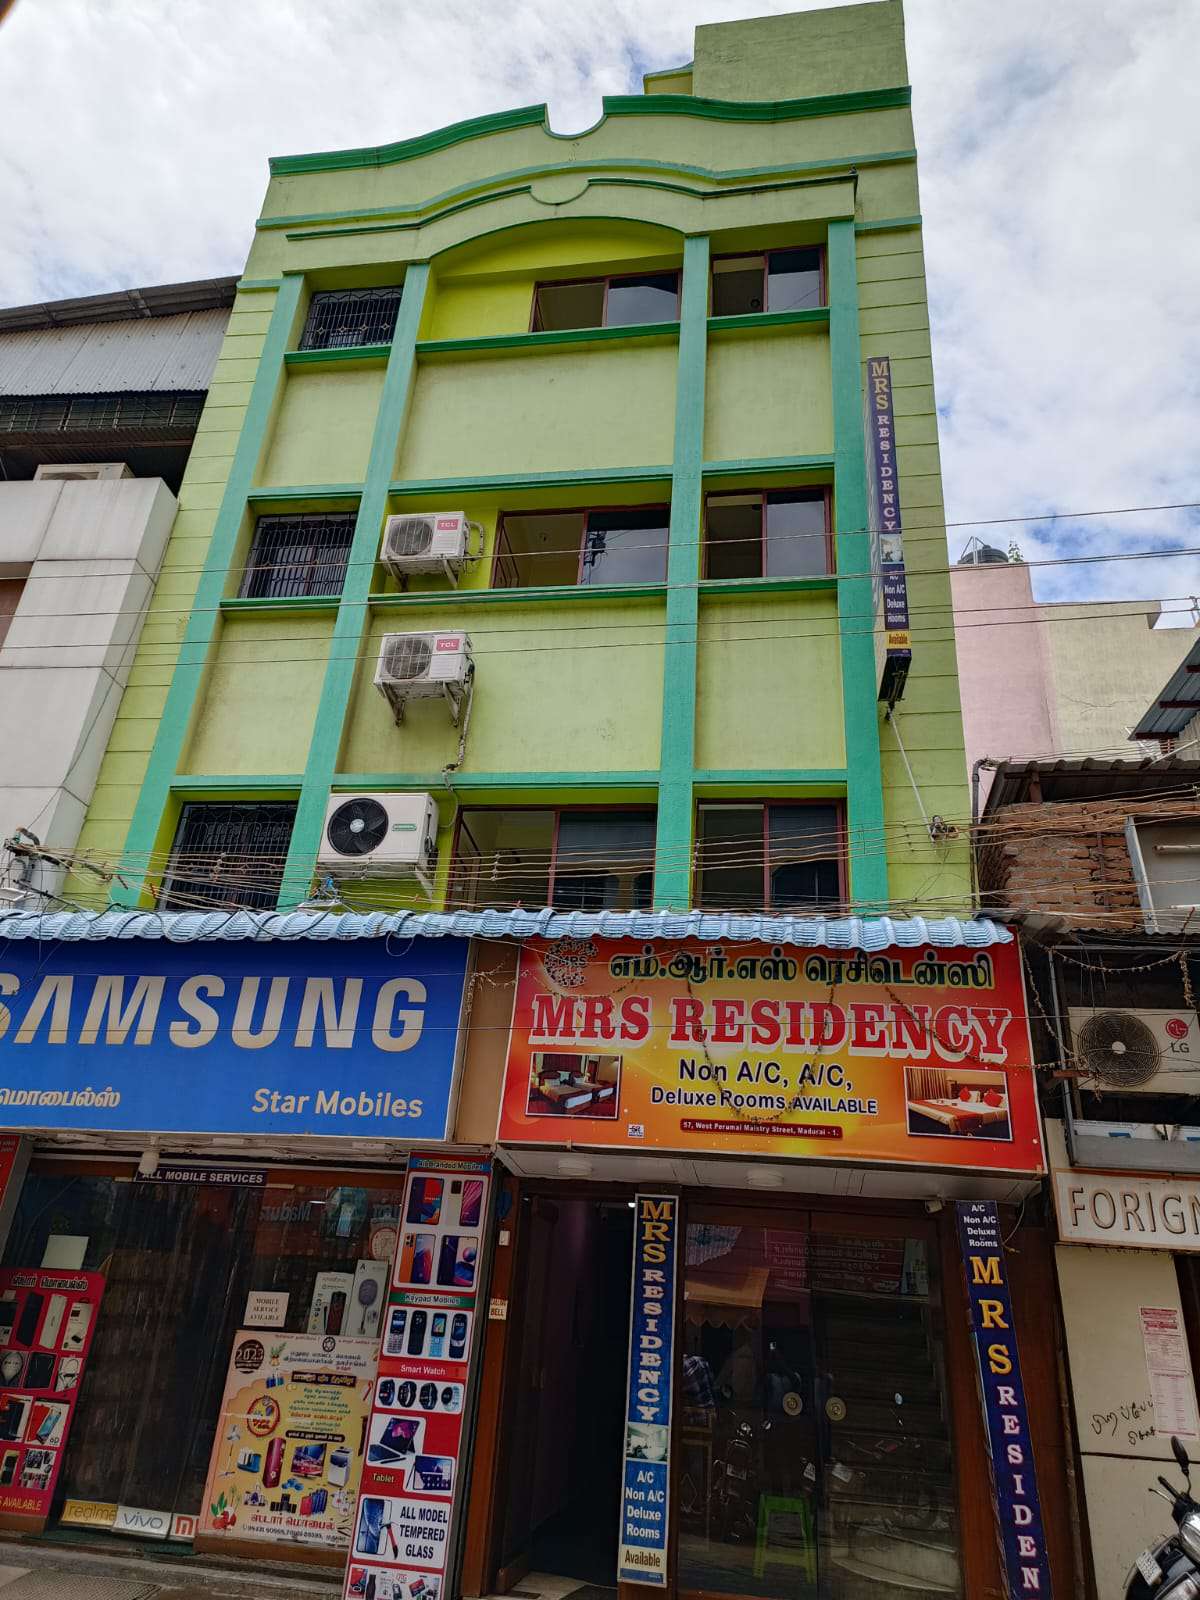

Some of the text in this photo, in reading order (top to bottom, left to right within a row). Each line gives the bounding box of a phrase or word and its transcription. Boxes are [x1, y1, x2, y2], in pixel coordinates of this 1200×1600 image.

[871, 361, 897, 531] MRS RESIDENCY
[529, 994, 1012, 1062] MRS RESIDENCY
[1171, 1042, 1190, 1054] LG
[678, 1058, 728, 1082] Non
[252, 1088, 424, 1118] Star Mobiles
[650, 1086, 878, 1114] Deluxe Rooms AVAILABLE
[695, 1122, 713, 1130] West
[797, 1127, 826, 1136] Madurai
[165, 1172, 207, 1182] MOBILE
[209, 1173, 264, 1184] SERVICES
[971, 1204, 985, 1212] A/C
[963, 1216, 997, 1224] Non A/C
[967, 1227, 996, 1236] Deluxe
[969, 1239, 998, 1248] Rooms
[636, 1200, 673, 1421] MRS RESIDENCY
[969, 1256, 1013, 1375] MRS
[236, 1348, 264, 1361] 2023
[400, 1364, 446, 1376] Smart Watch
[373, 1472, 395, 1483] Tablet
[637, 1470, 654, 1484] A/C
[625, 1487, 665, 1503] Non A/C
[124, 1512, 163, 1529] vivo
[400, 1506, 448, 1523] ALL MODEL
[627, 1505, 661, 1521] Deluxe
[400, 1525, 445, 1541] TEMPERED
[627, 1523, 660, 1540] Rooms
[405, 1544, 434, 1559] GLASS
[625, 1549, 661, 1567] Available
